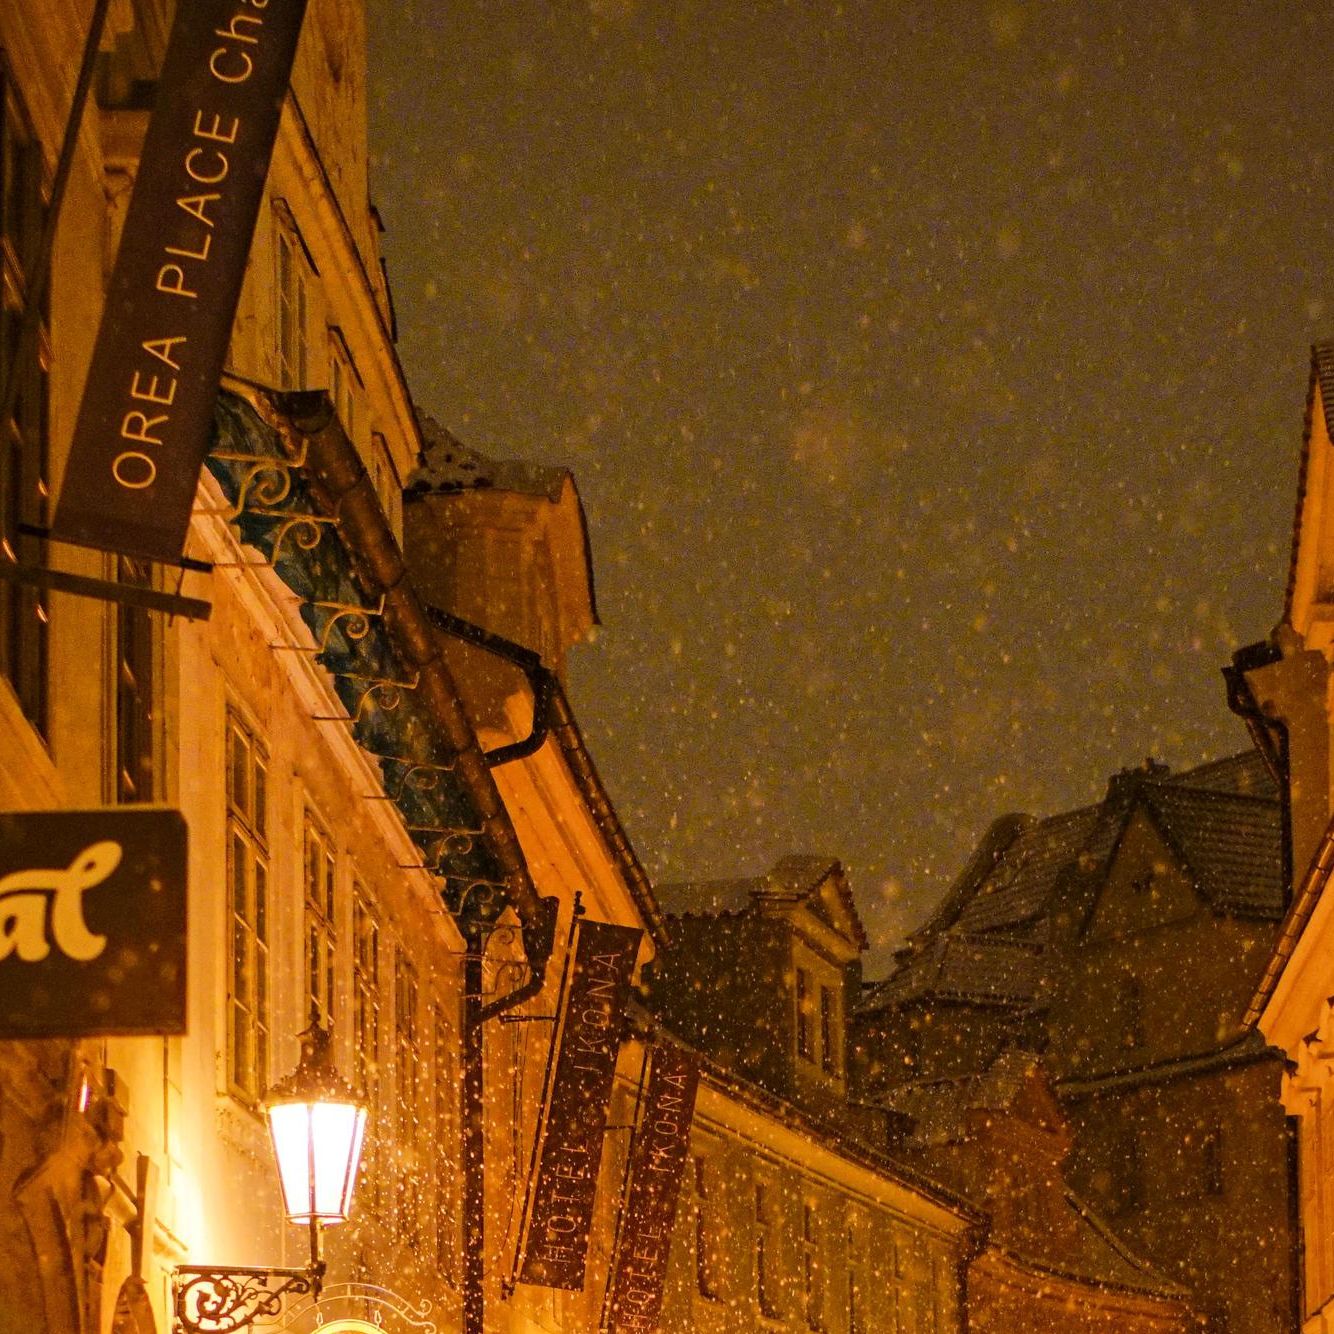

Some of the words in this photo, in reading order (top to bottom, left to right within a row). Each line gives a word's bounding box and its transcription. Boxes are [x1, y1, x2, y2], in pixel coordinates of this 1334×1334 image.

[113, 336, 187, 489] OREA
[156, 109, 239, 299] PLACE
[541, 1139, 588, 1264] HOTEL
[573, 953, 621, 1076] IKONA
[620, 1228, 662, 1329] HOTEL
[649, 1074, 688, 1172] IKONA
